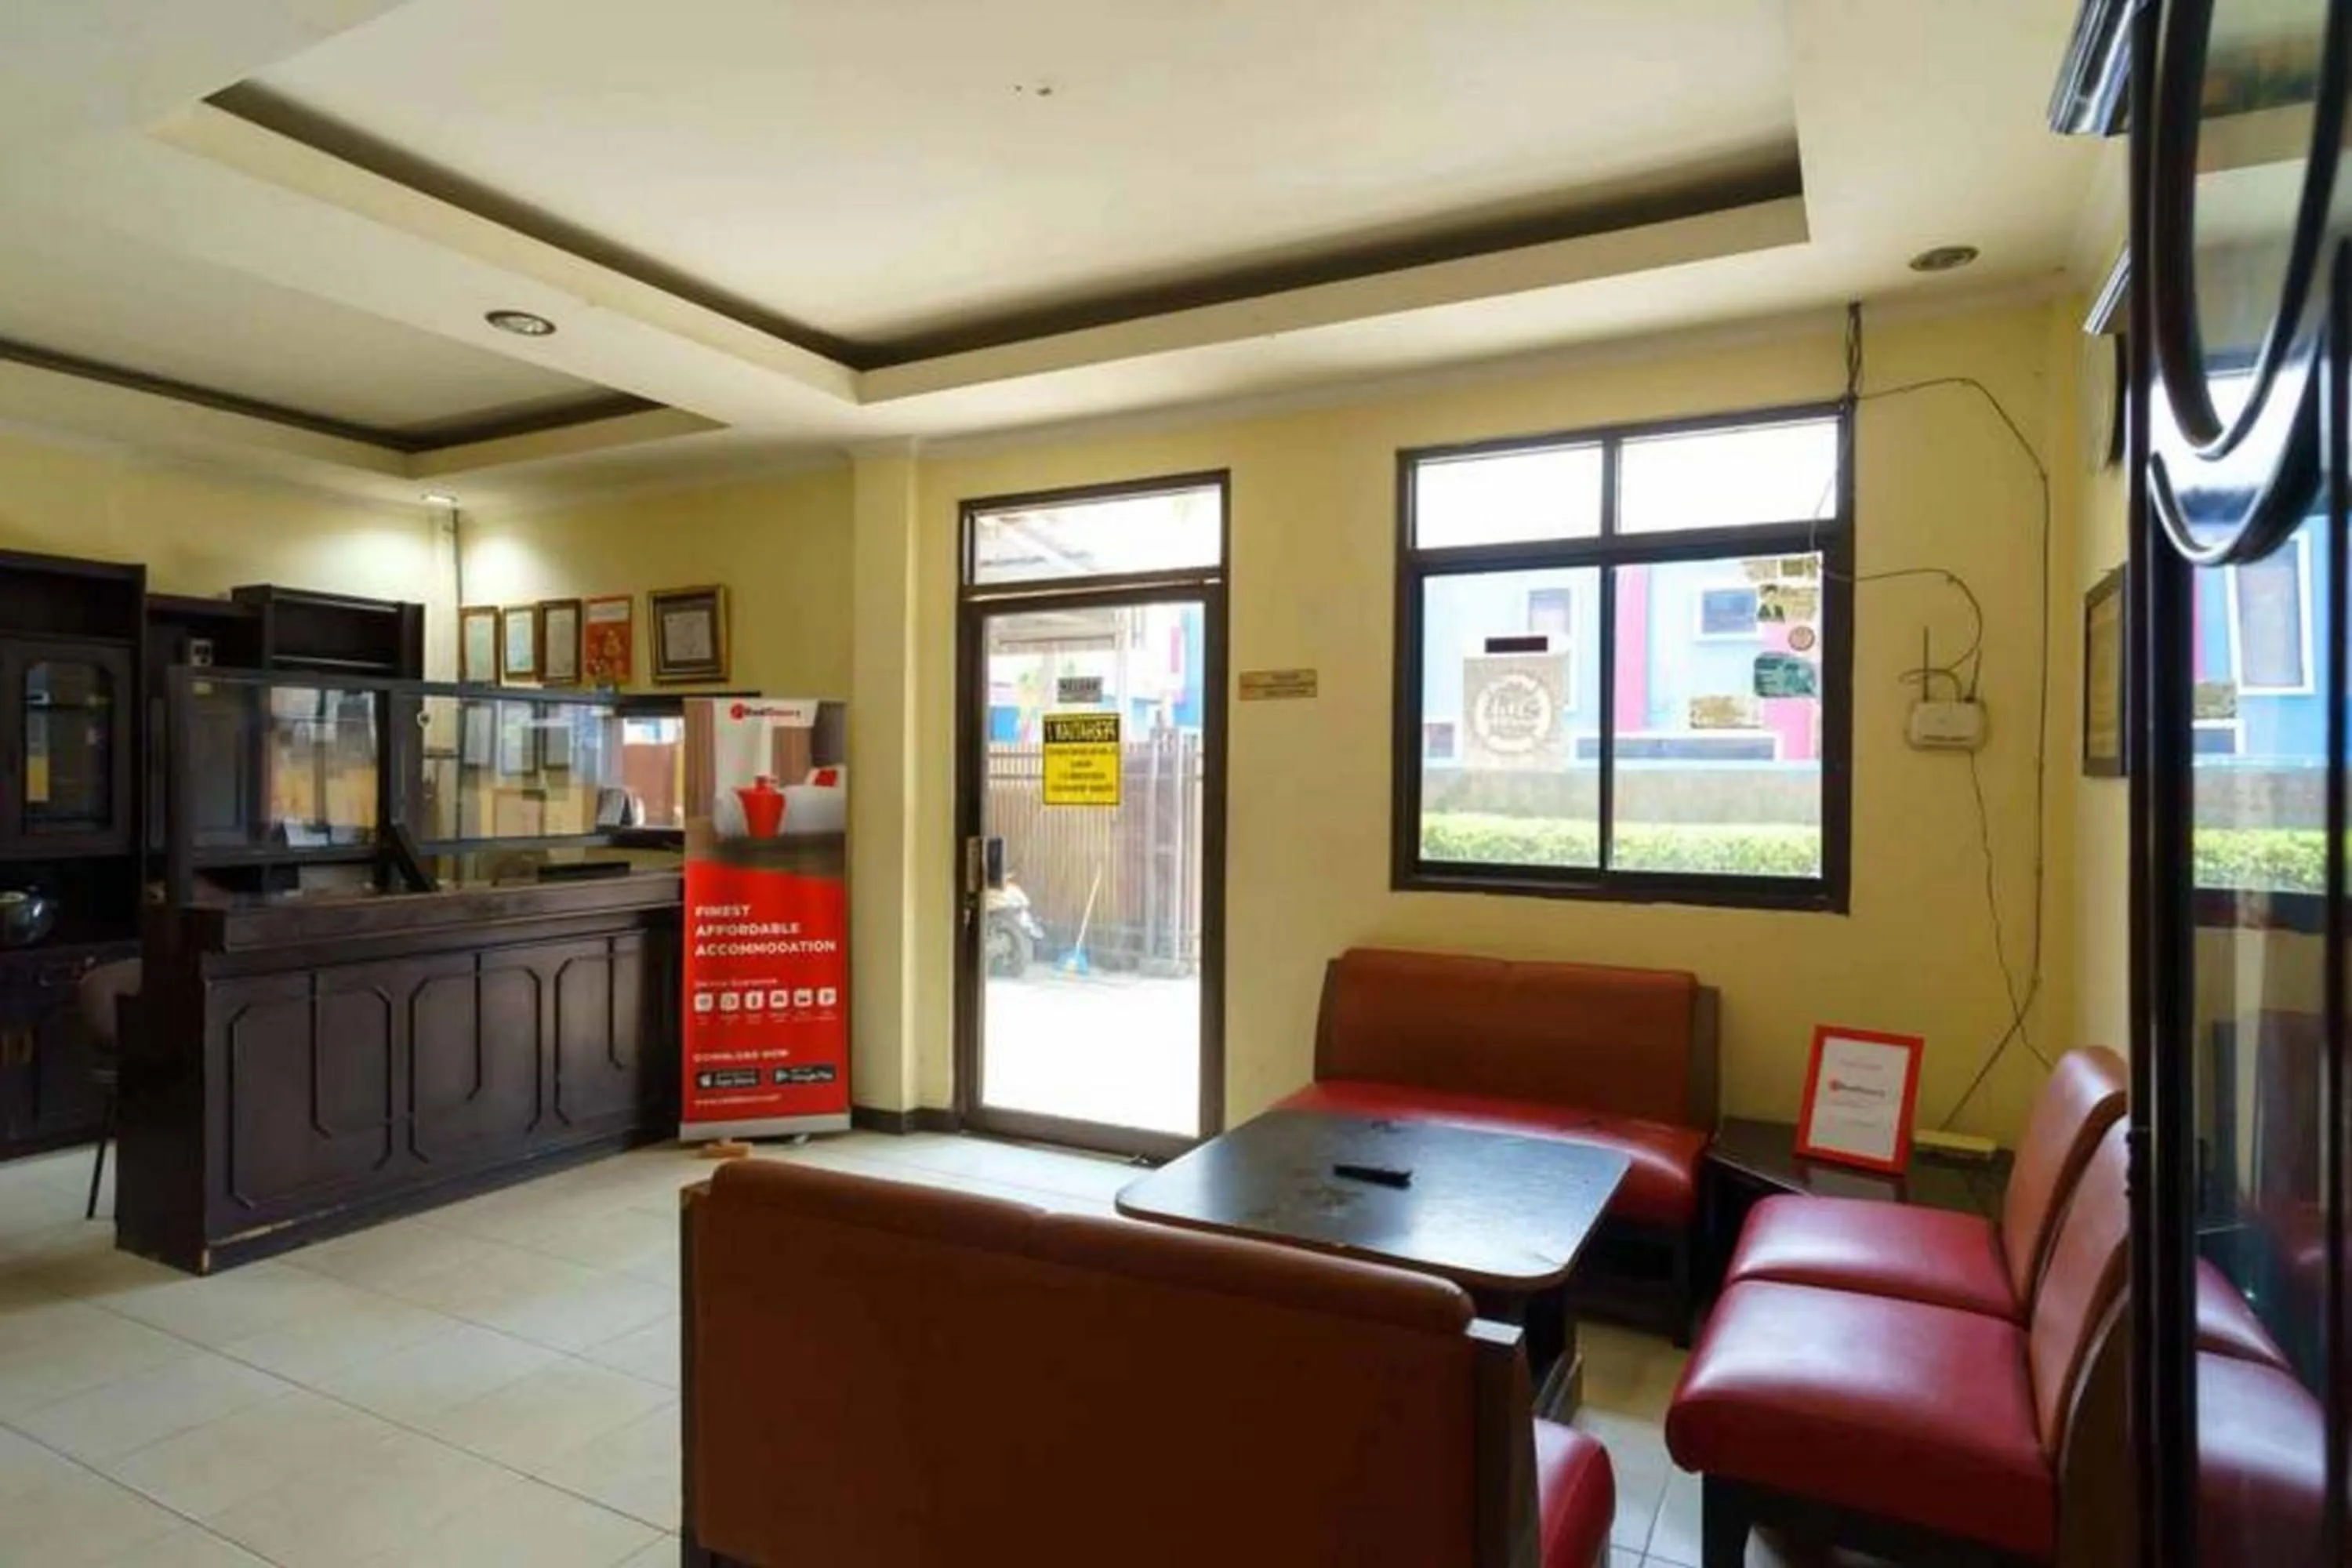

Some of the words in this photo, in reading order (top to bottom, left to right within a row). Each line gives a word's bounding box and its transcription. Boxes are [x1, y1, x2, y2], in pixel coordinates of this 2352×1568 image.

[695, 905, 751, 917] FINEST
[695, 922, 800, 937] AFFORDABLE
[695, 940, 837, 956] ACCOMMODATION
